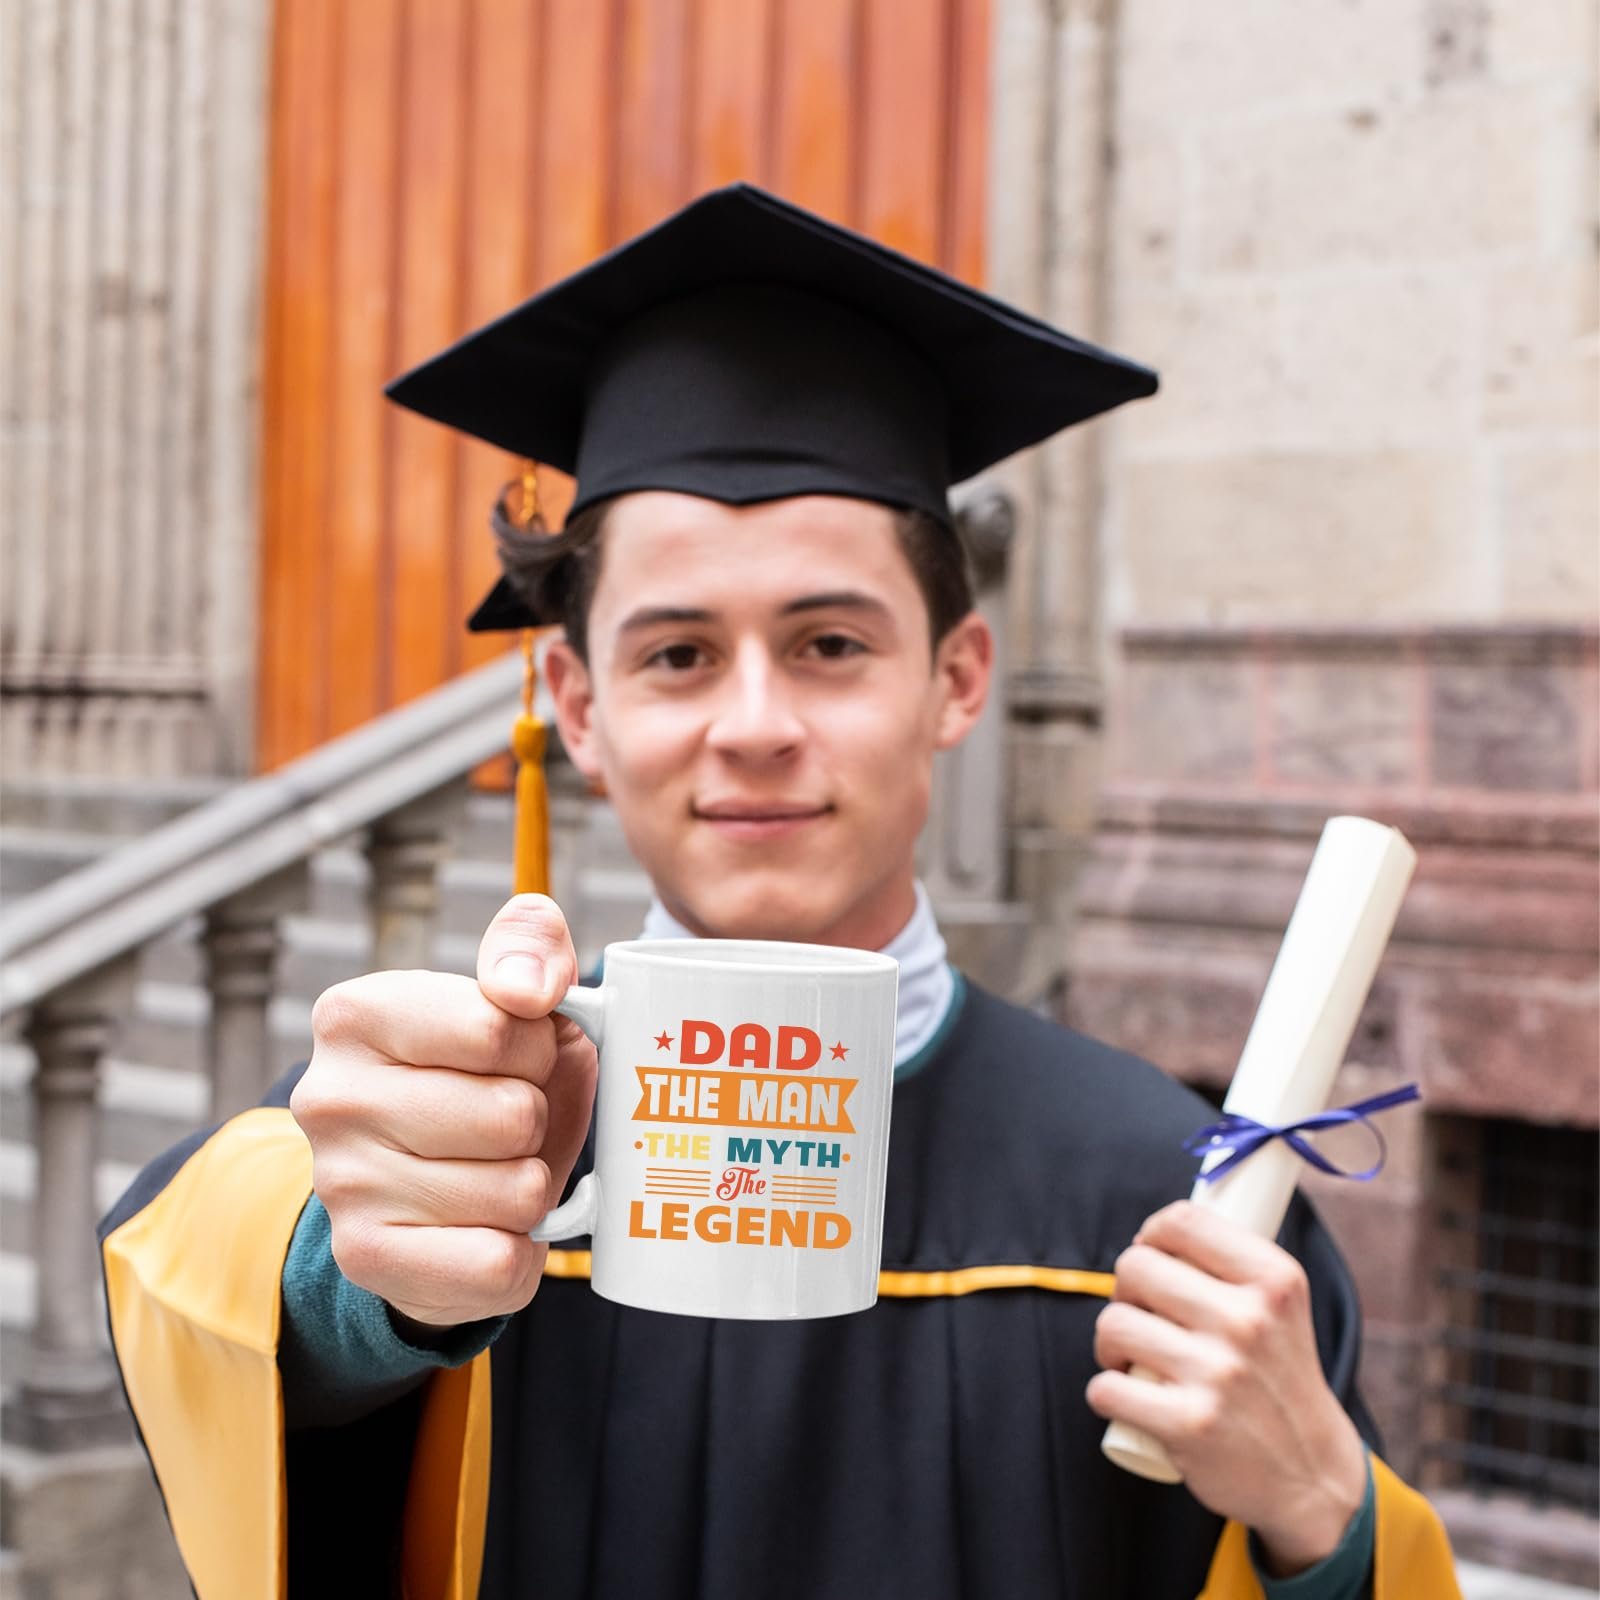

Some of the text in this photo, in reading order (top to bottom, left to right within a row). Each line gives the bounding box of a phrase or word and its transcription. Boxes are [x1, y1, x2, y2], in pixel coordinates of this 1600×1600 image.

[680, 1020, 822, 1071] DAD
[644, 1073, 841, 1126] THE MAN
[644, 1132, 841, 1168] THE MYTH
[716, 1167, 767, 1201] The
[628, 1200, 852, 1250] LEGEND
